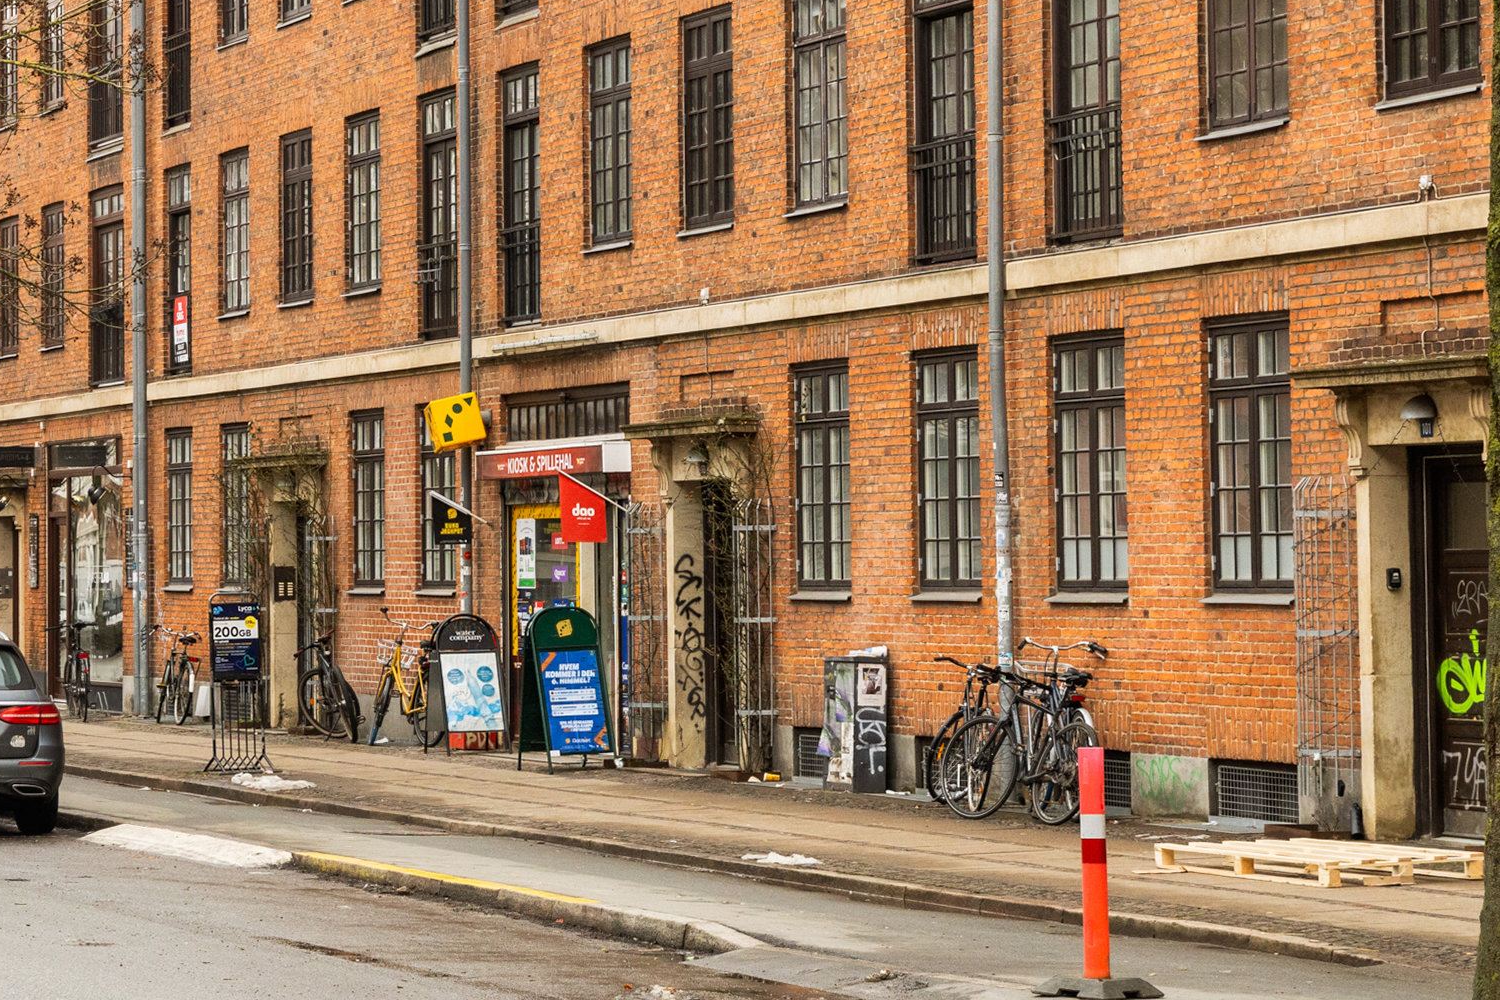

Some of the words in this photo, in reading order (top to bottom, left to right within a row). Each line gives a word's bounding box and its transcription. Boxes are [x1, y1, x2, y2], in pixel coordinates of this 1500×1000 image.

[507, 457, 529, 474] KIOSK
[529, 456, 536, 473] &
[536, 453, 574, 472] SPILLEHAL
[572, 502, 595, 517] dao
[449, 634, 483, 643] company
[559, 663, 580, 671] HVEM
[545, 670, 576, 679] KOMMER
[581, 669, 596, 677] DEN
